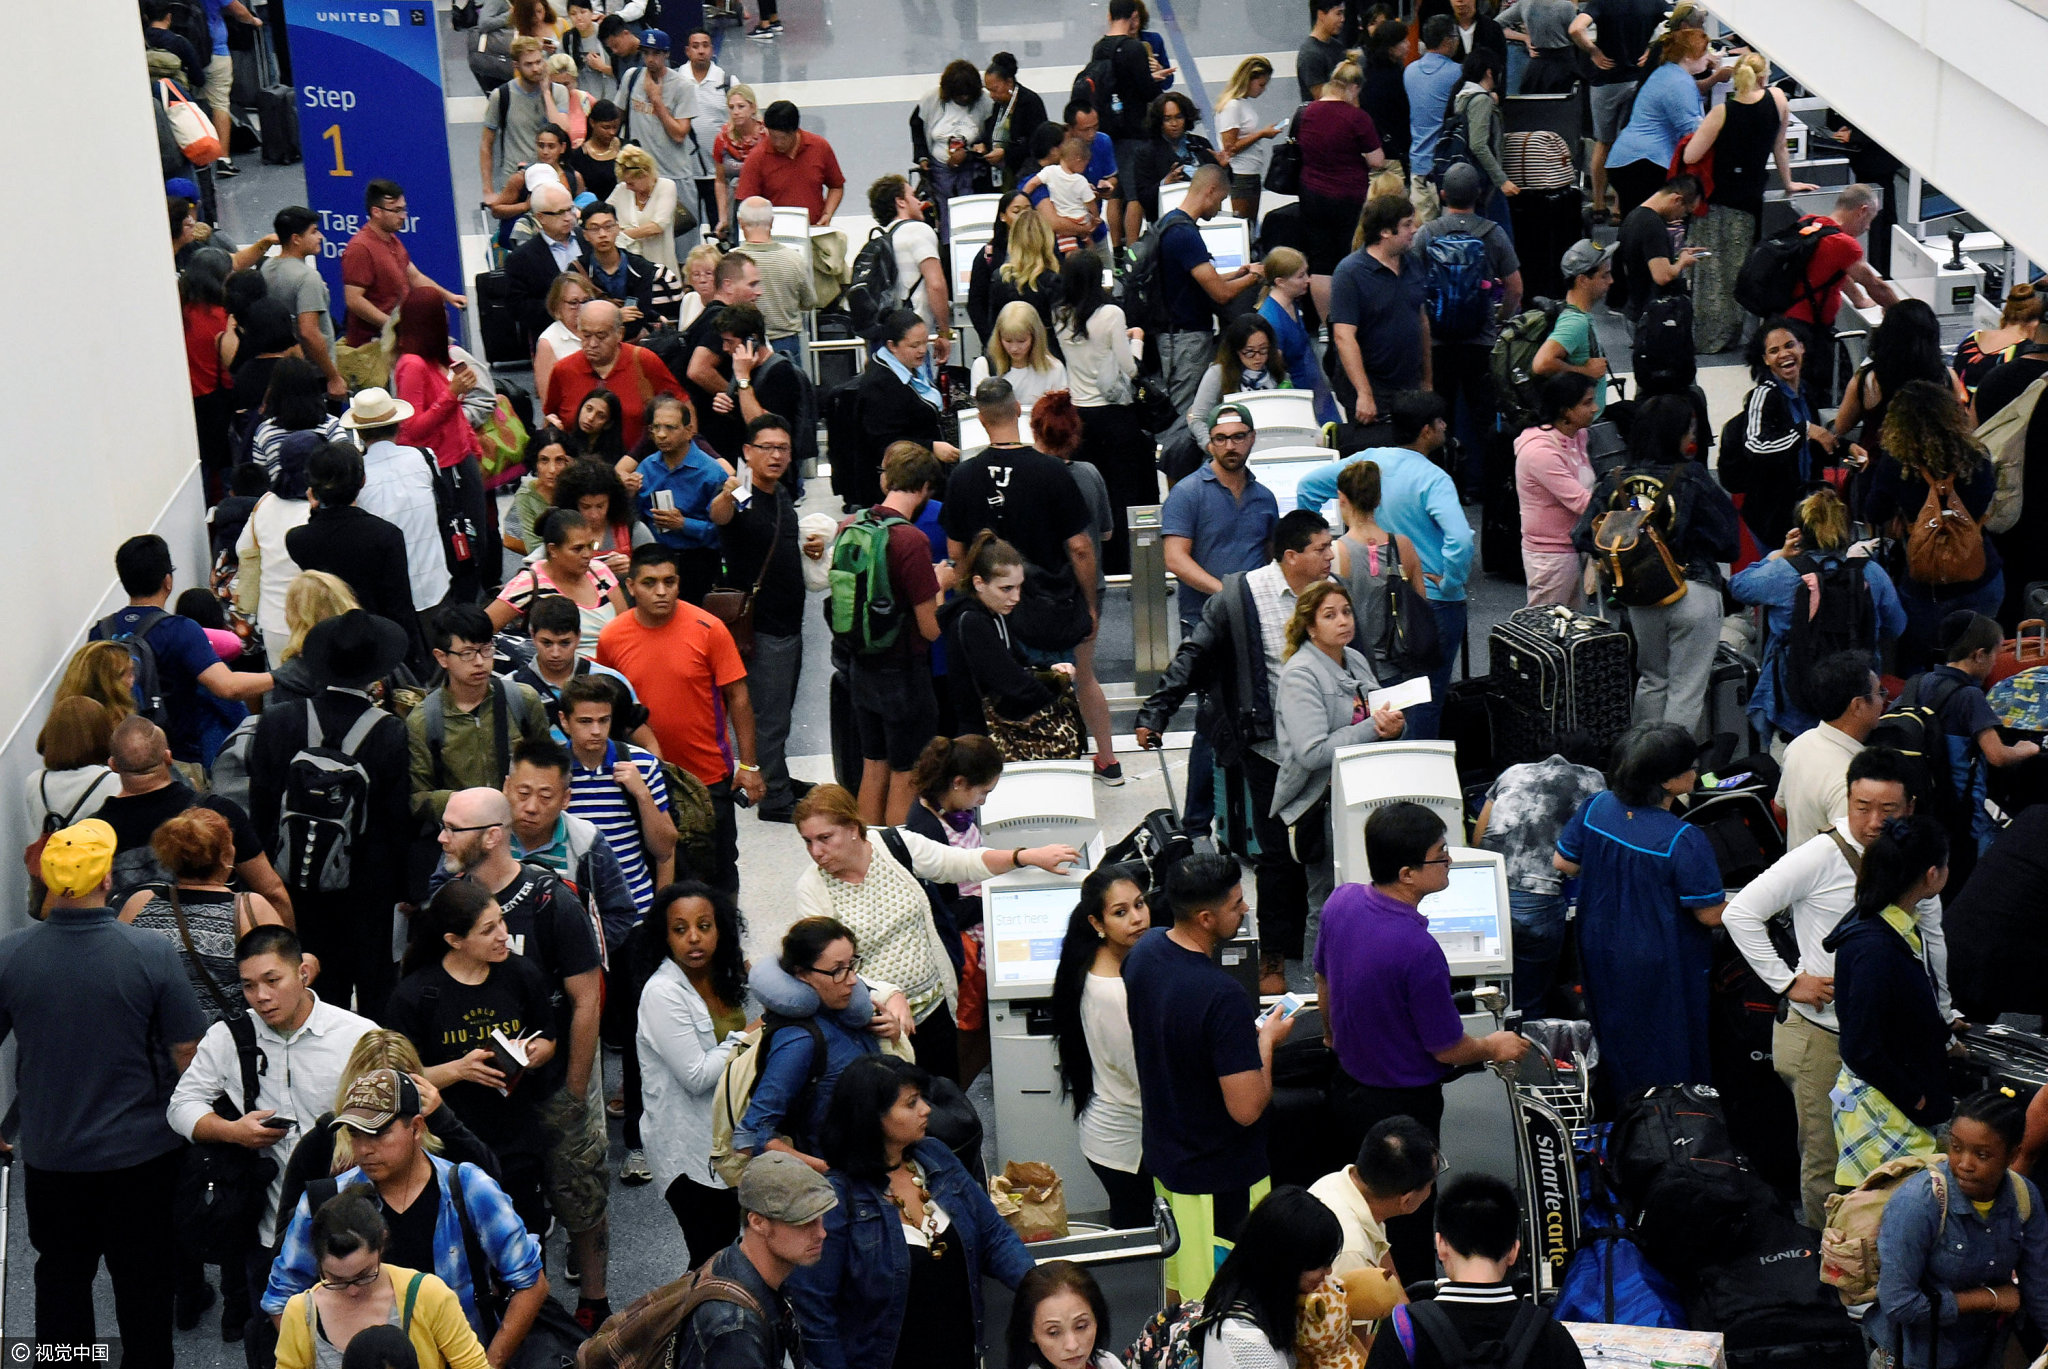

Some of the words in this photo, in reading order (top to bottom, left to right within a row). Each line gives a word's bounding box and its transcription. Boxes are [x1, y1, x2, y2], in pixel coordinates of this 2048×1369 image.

[315, 12, 381, 23] UNITED
[303, 85, 357, 112] Step
[322, 123, 354, 177] 1
[317, 209, 360, 235] Tag
[996, 914, 1022, 926] Start
[1025, 912, 1049, 924] here
[1535, 1134, 1570, 1268] smartecarte
